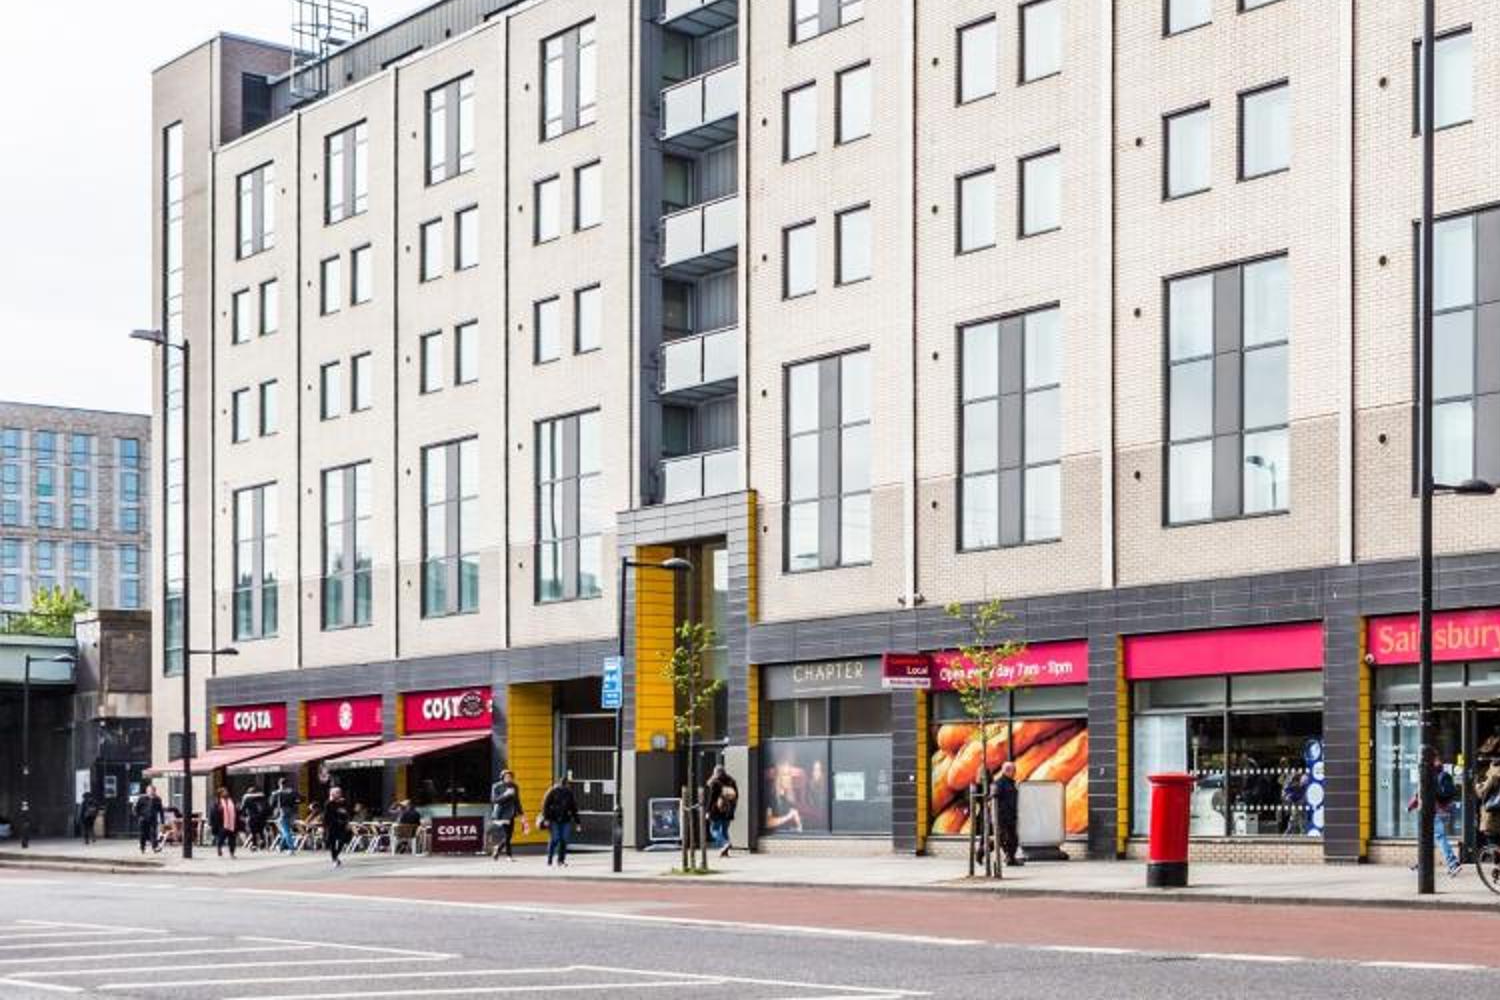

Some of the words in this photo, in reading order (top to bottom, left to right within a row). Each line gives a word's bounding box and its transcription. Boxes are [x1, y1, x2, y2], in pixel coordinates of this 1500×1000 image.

[793, 661, 864, 683] CHAPTER
[905, 665, 929, 675] Local
[422, 696, 464, 721] COST
[233, 711, 273, 731] COSTA
[437, 825, 477, 835] COSTA
